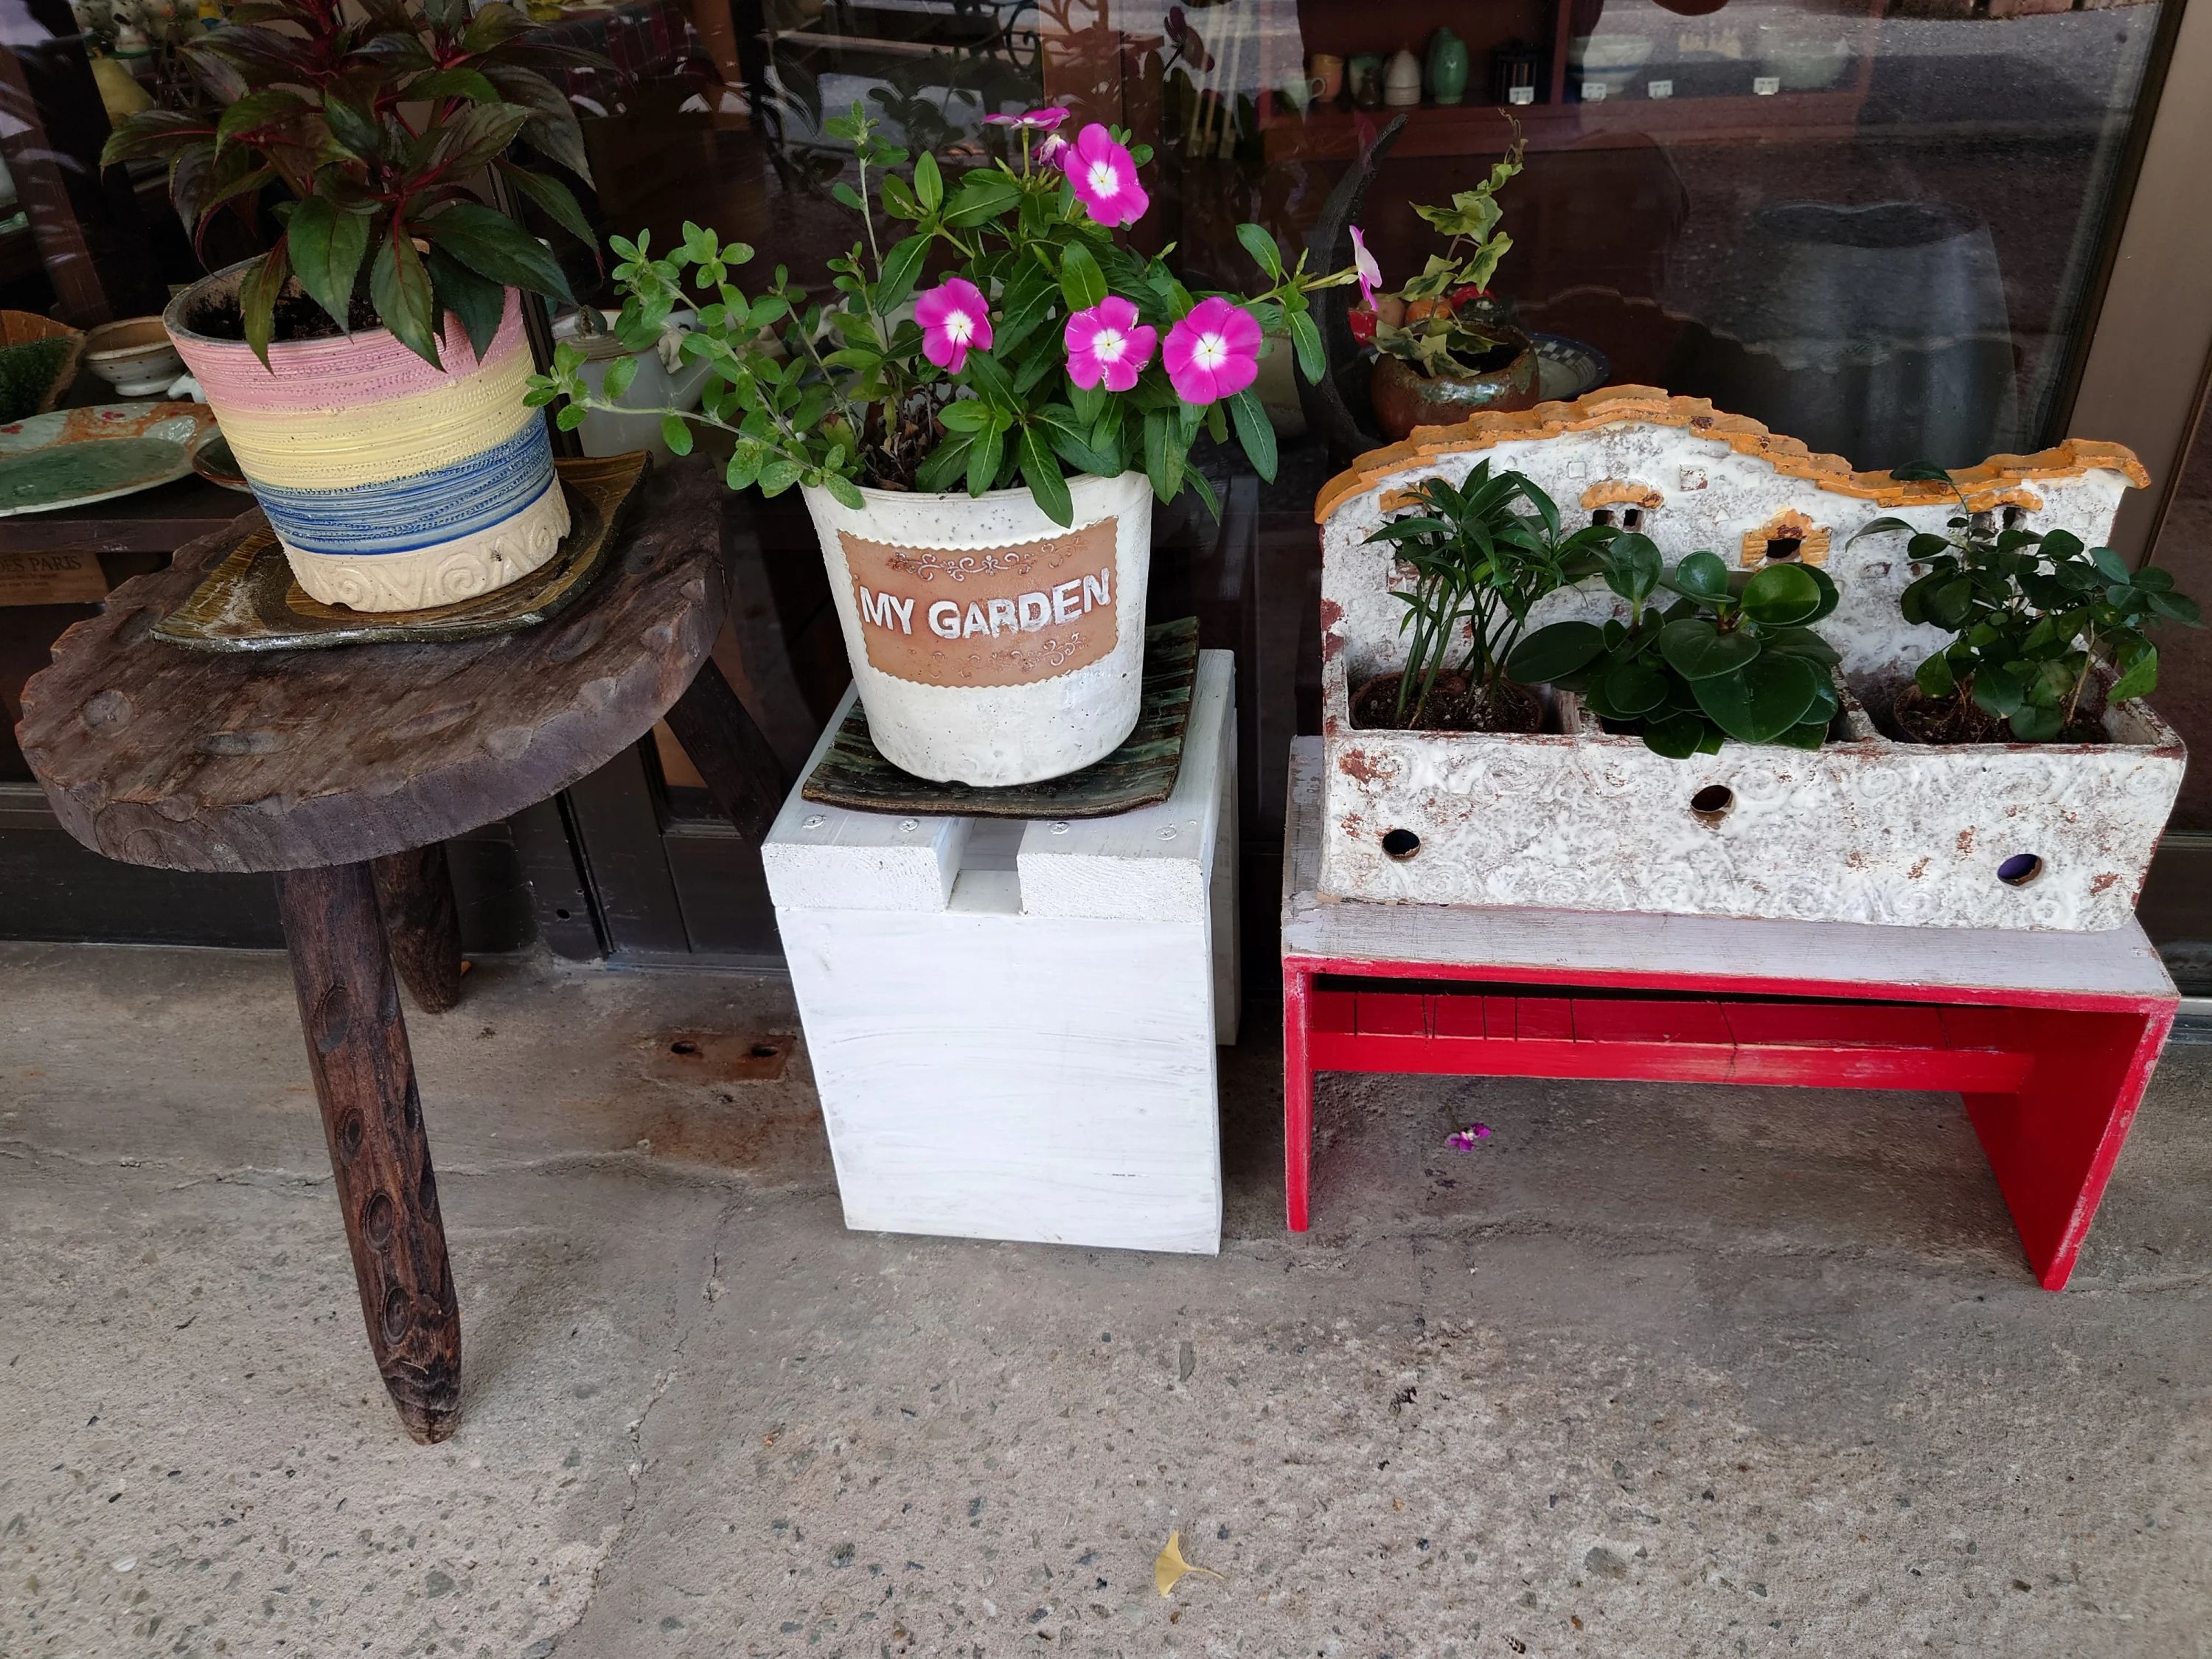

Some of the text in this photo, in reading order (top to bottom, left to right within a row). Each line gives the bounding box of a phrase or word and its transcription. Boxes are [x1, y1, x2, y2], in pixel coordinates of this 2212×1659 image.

[28, 555, 83, 571] PARIS
[860, 567, 1110, 639] MY GARDEN
